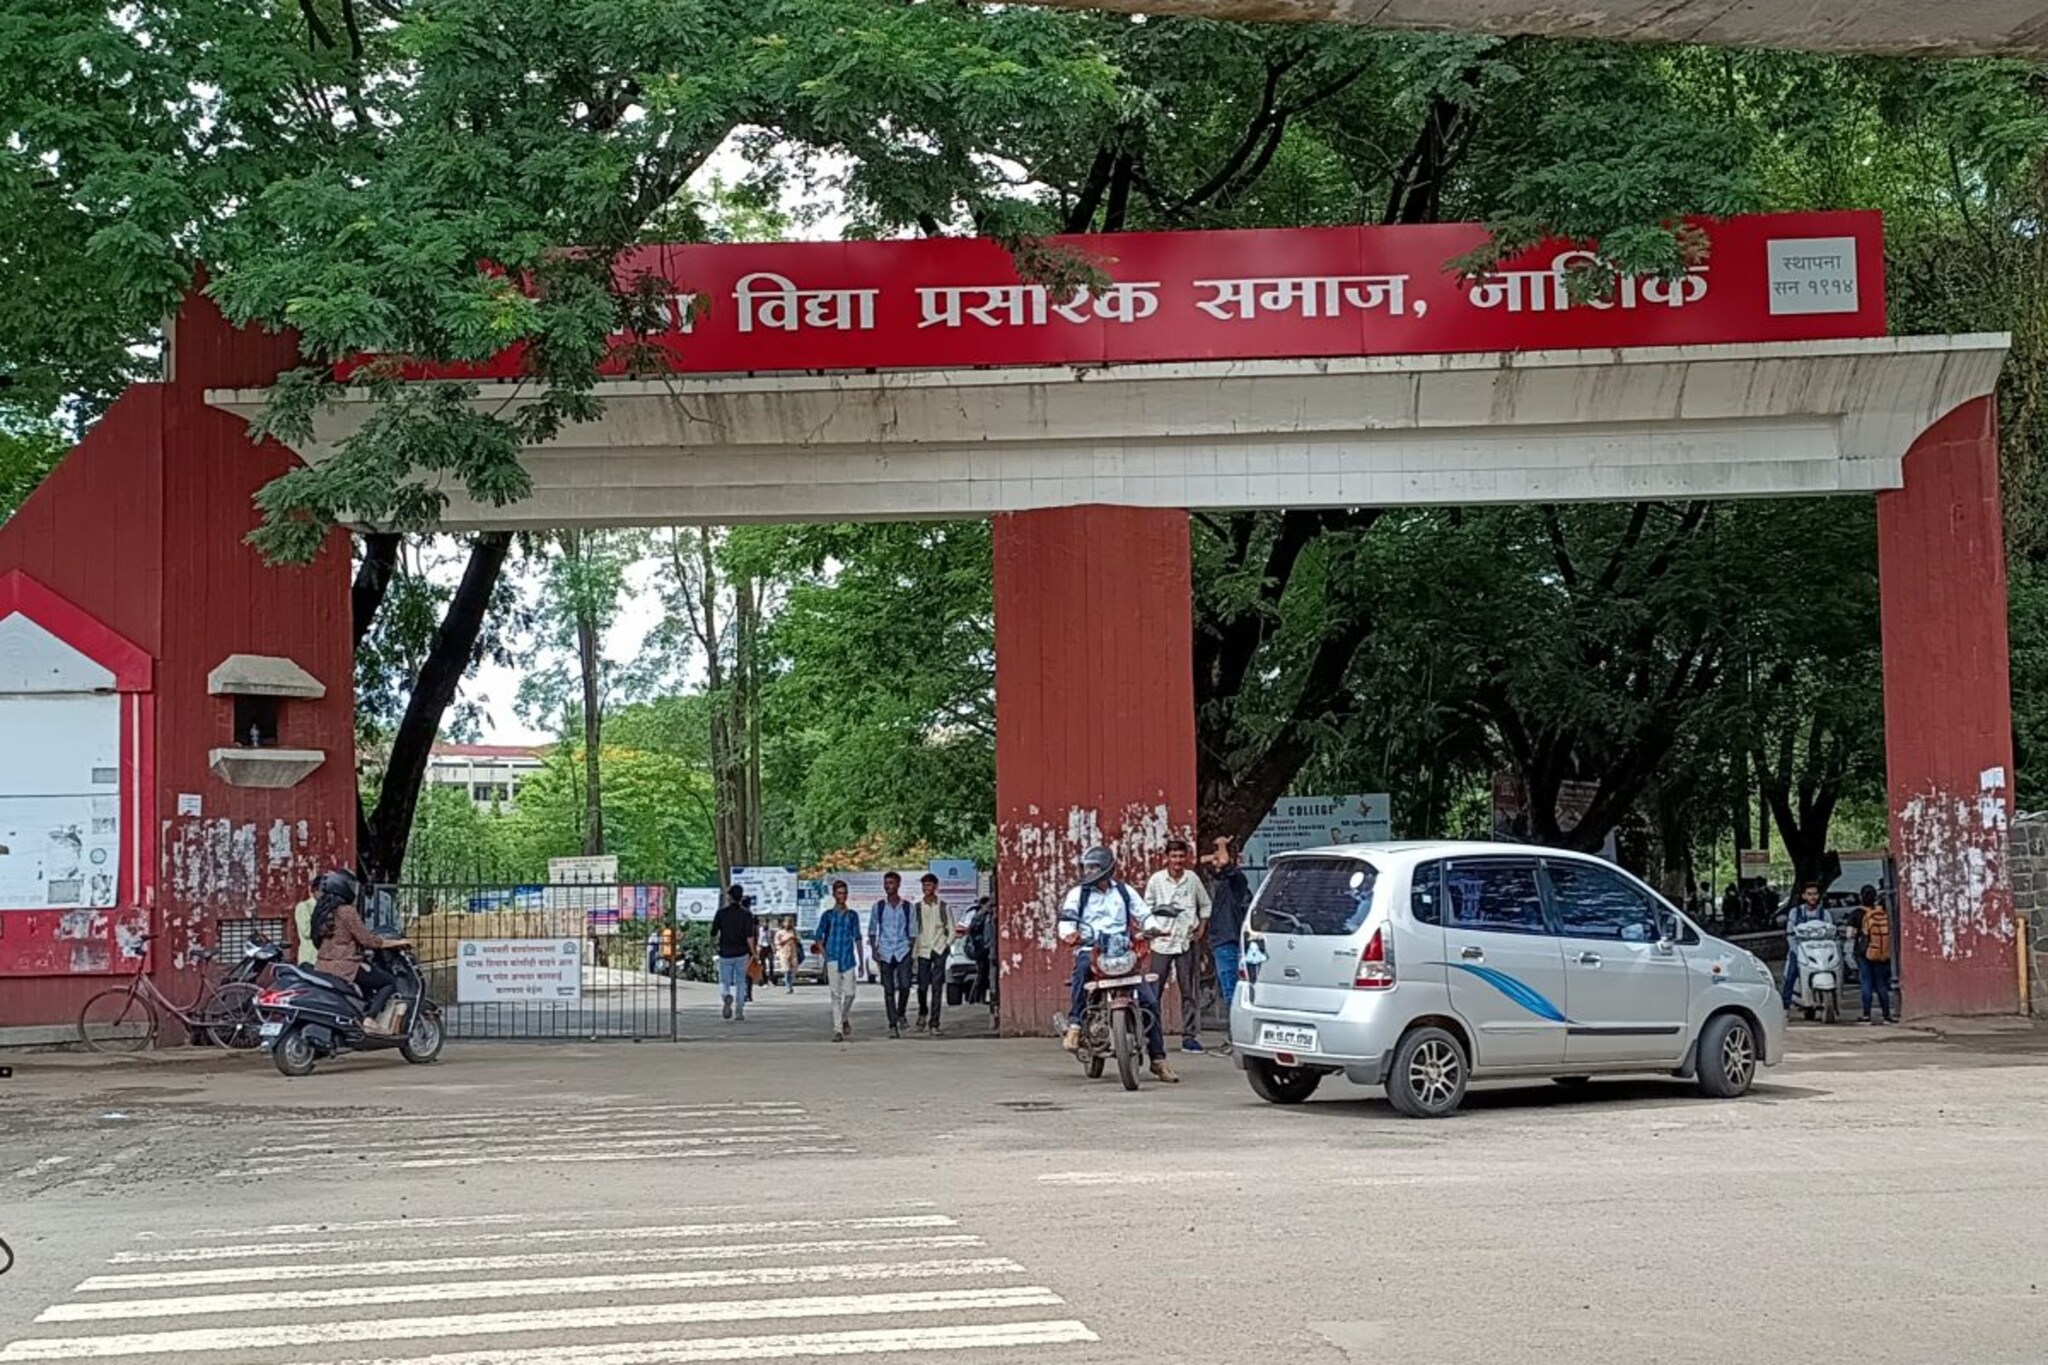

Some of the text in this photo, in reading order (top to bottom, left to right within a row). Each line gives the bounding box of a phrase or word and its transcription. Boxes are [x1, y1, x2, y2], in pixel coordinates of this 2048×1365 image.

[1782, 255, 1841, 271] स्थापना
[1774, 279, 1853, 295] सन १९१४
[732, 272, 879, 333] विद्या
[915, 281, 1160, 329] प्रसारक
[1193, 273, 1429, 320] समाज,
[1288, 804, 1334, 816] COLLEGE
